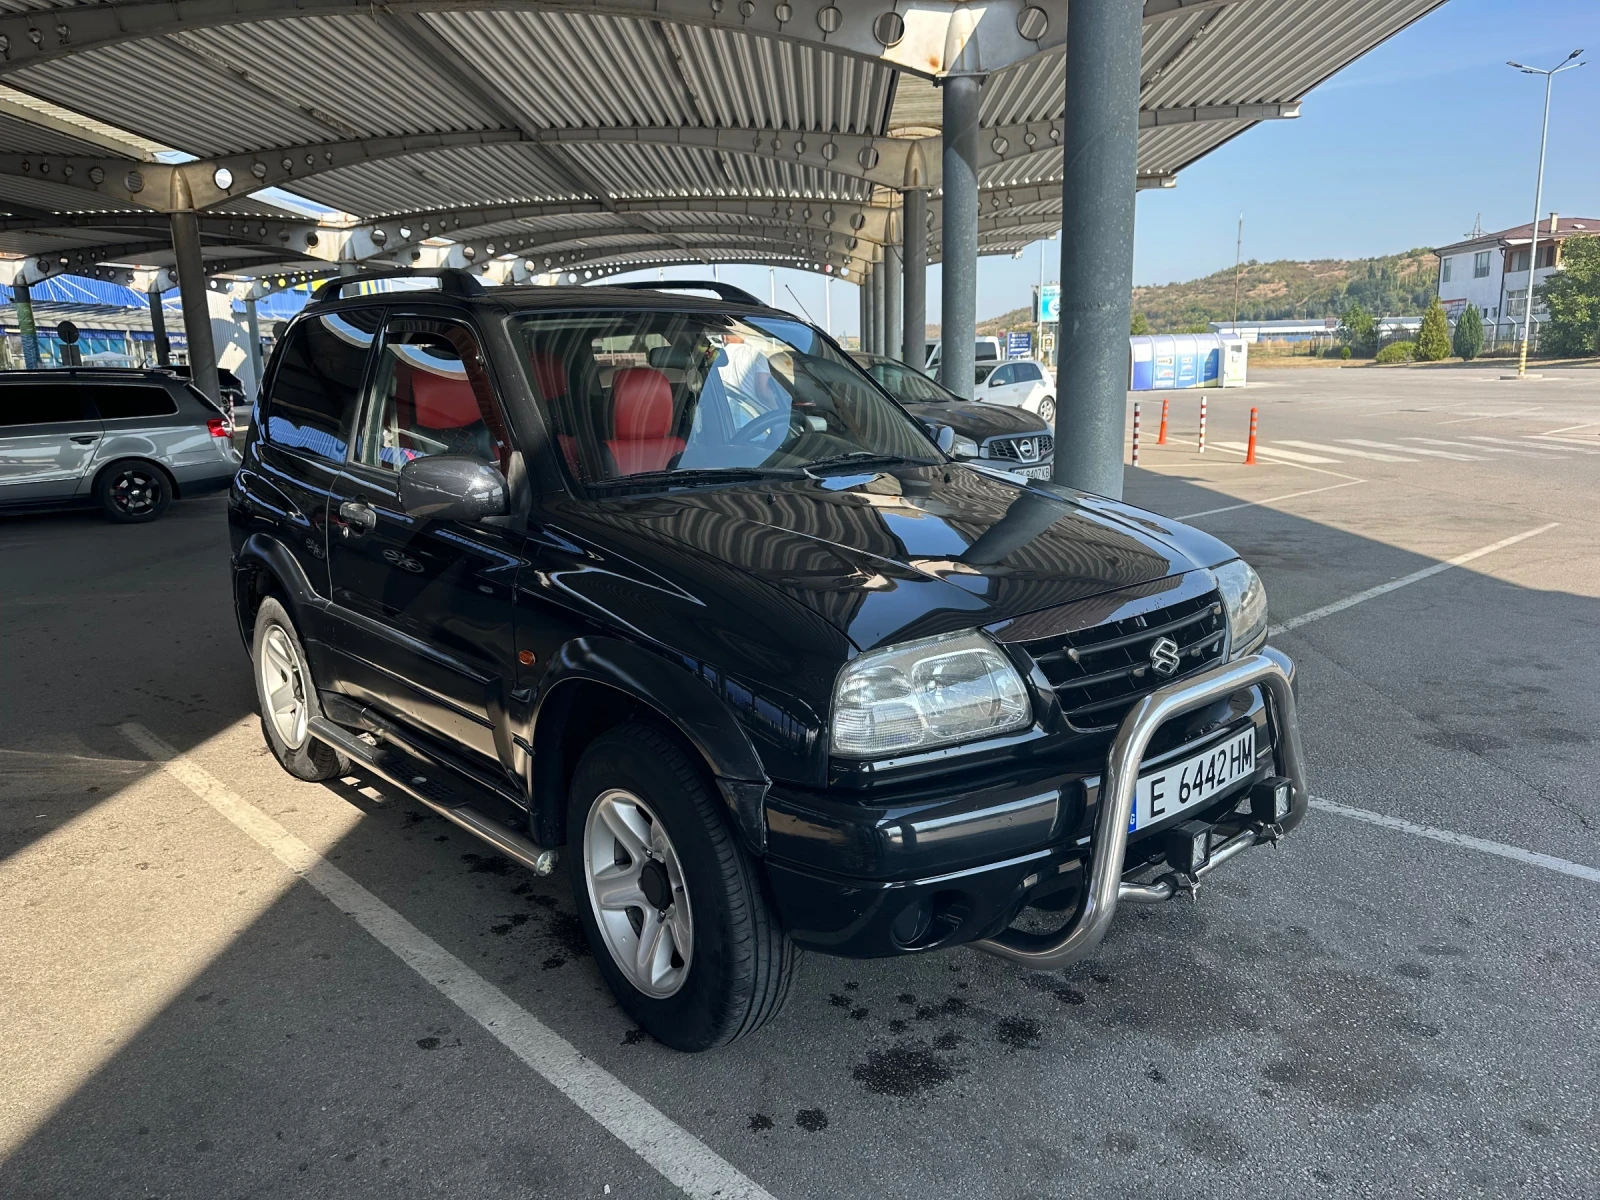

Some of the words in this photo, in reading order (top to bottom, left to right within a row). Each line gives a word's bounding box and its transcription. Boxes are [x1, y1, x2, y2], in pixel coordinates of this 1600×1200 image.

[1150, 776, 1166, 818] E
[1179, 749, 1227, 804] 6442
[1229, 733, 1252, 778] HM
[1129, 813, 1136, 825] G
